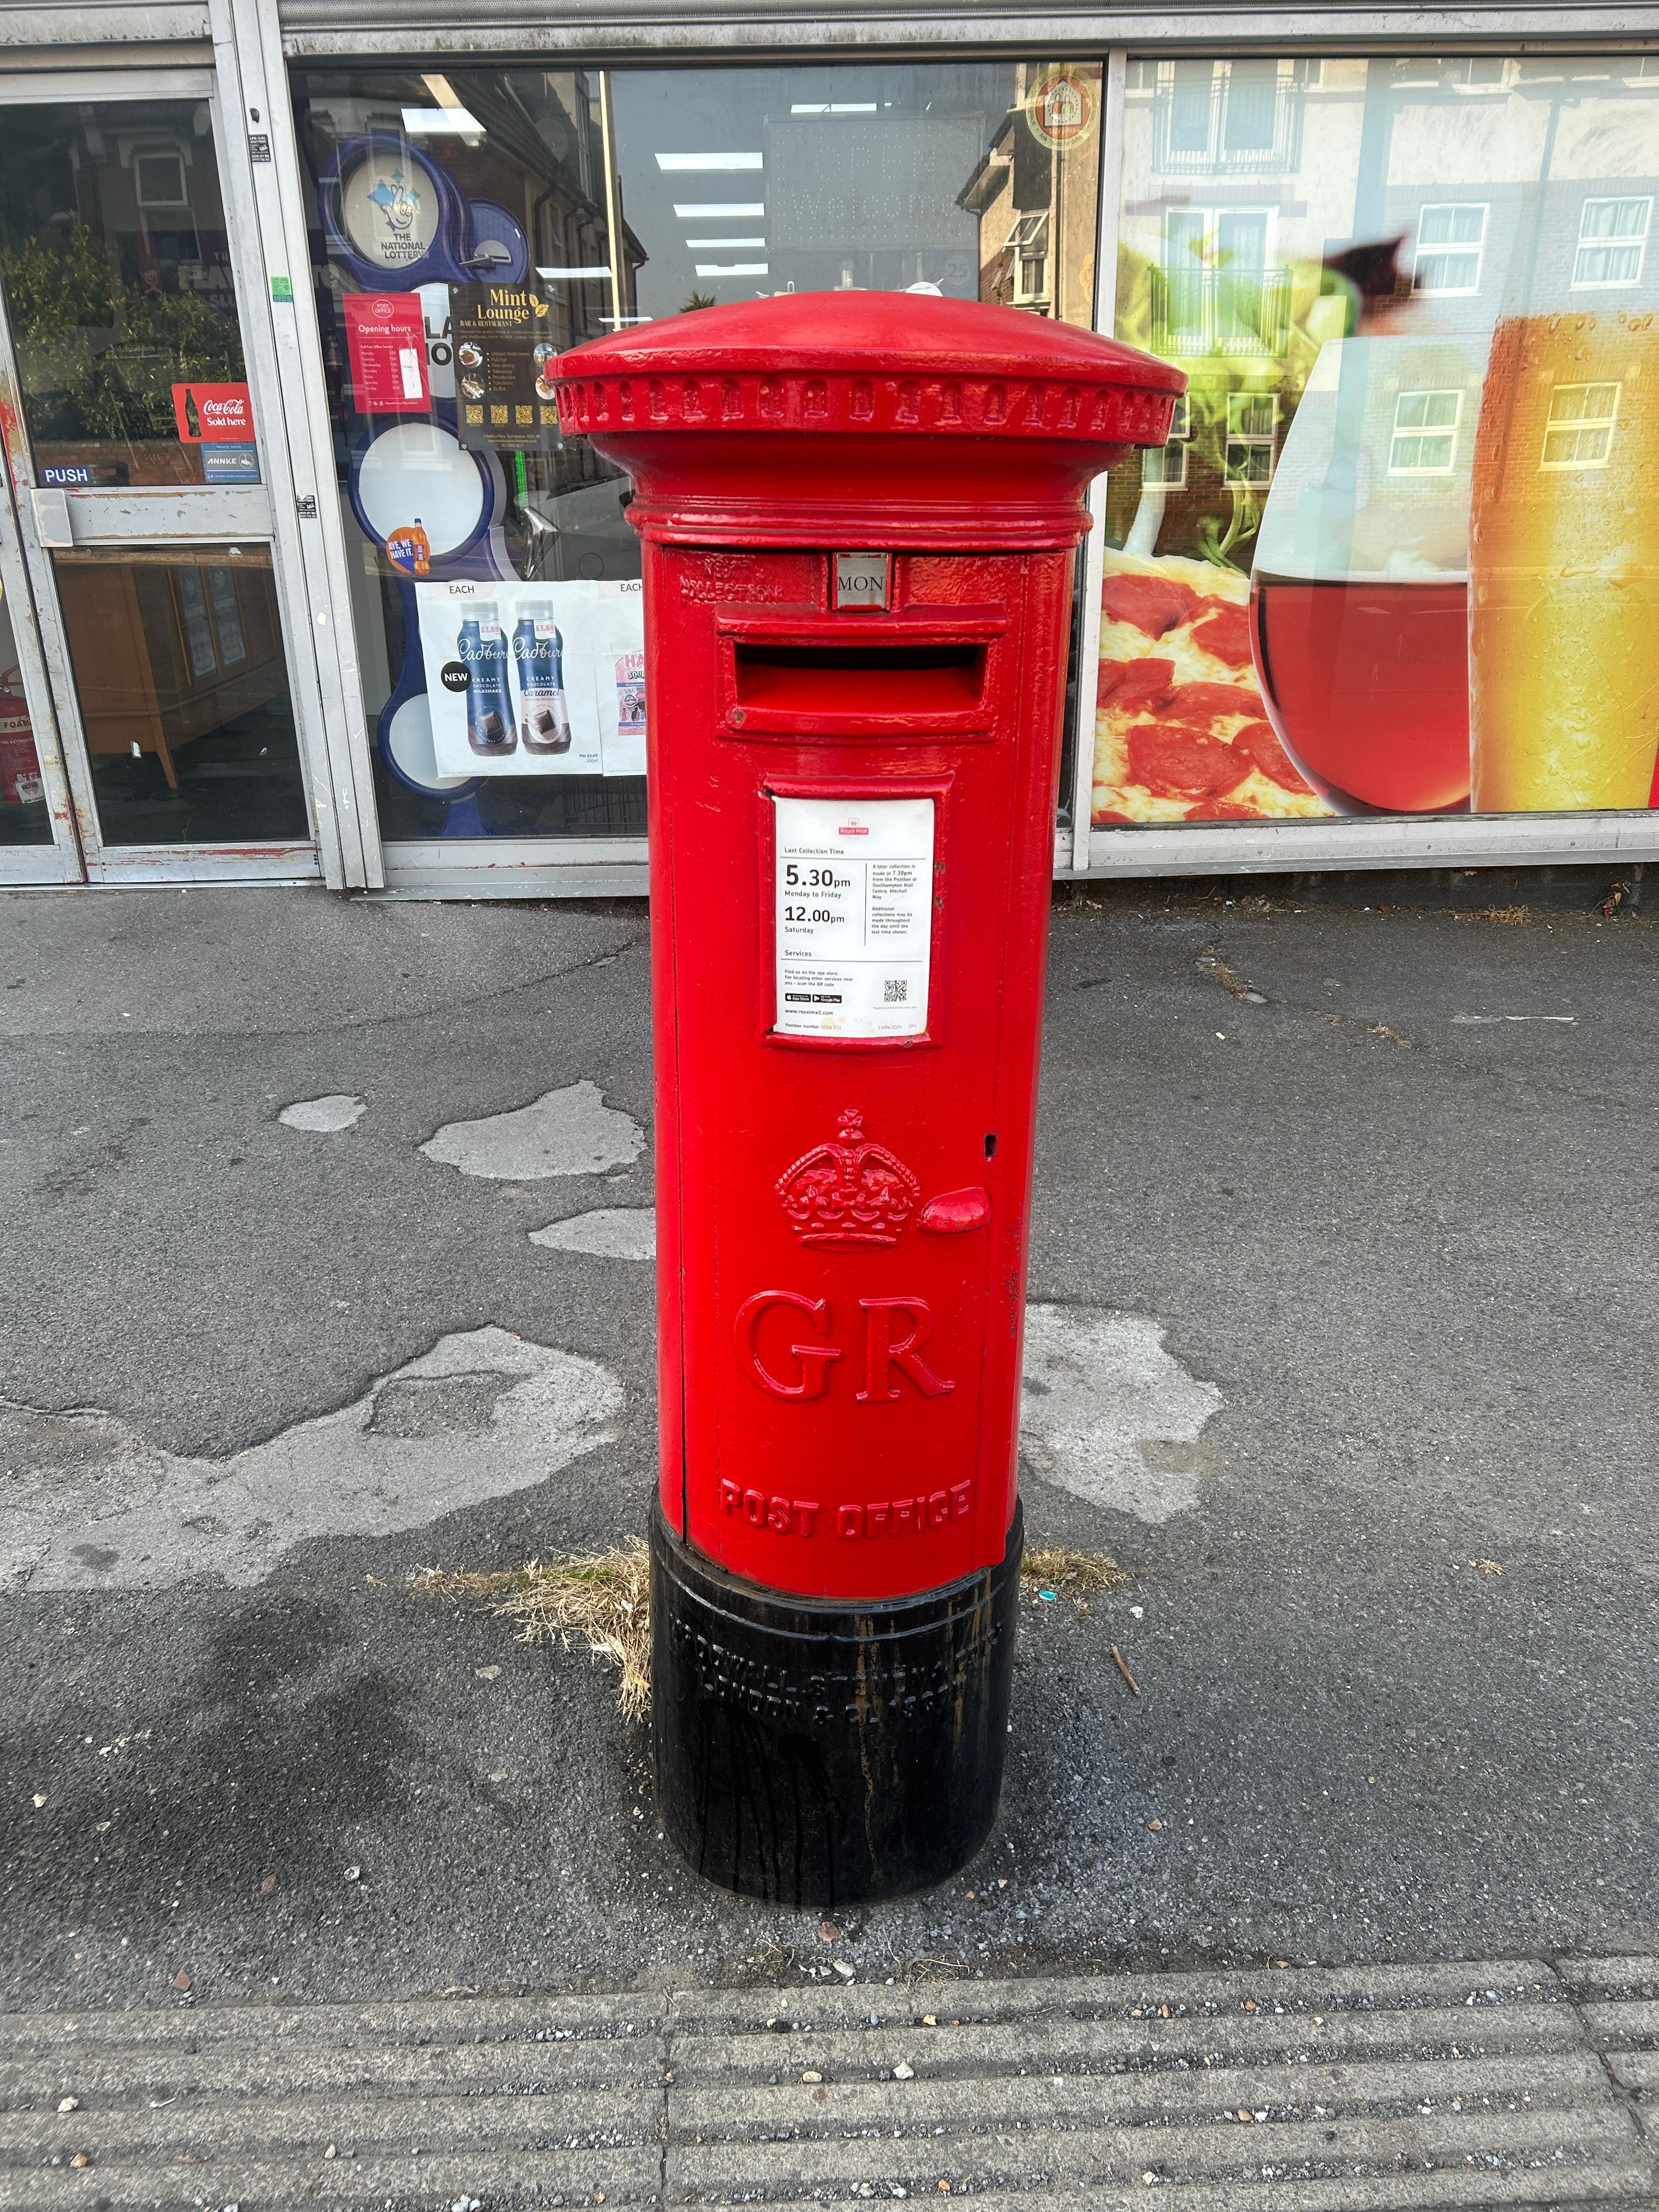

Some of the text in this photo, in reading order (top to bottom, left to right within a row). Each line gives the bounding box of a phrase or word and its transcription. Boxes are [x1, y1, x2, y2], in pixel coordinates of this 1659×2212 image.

[381, 241, 426, 250] NATIONAL
[490, 289, 527, 306] Mint
[477, 304, 529, 324] Lounge
[358, 323, 411, 335] Opening hours
[206, 417, 246, 426] Sold here
[44, 469, 88, 482] PUSH
[388, 539, 411, 550] AYE, WE
[390, 548, 414, 560] HAVE IT.
[449, 585, 475, 594] EACH
[838, 576, 884, 591] MON
[444, 673, 468, 681] NEW
[524, 688, 560, 697] Caramel
[786, 865, 850, 889] 5.30pm
[785, 890, 810, 898] Monday
[785, 906, 844, 924] 12.00pm
[785, 926, 814, 934] Saturday
[735, 1290, 957, 1403] GR
[720, 1478, 972, 1540] POST OFFICE
